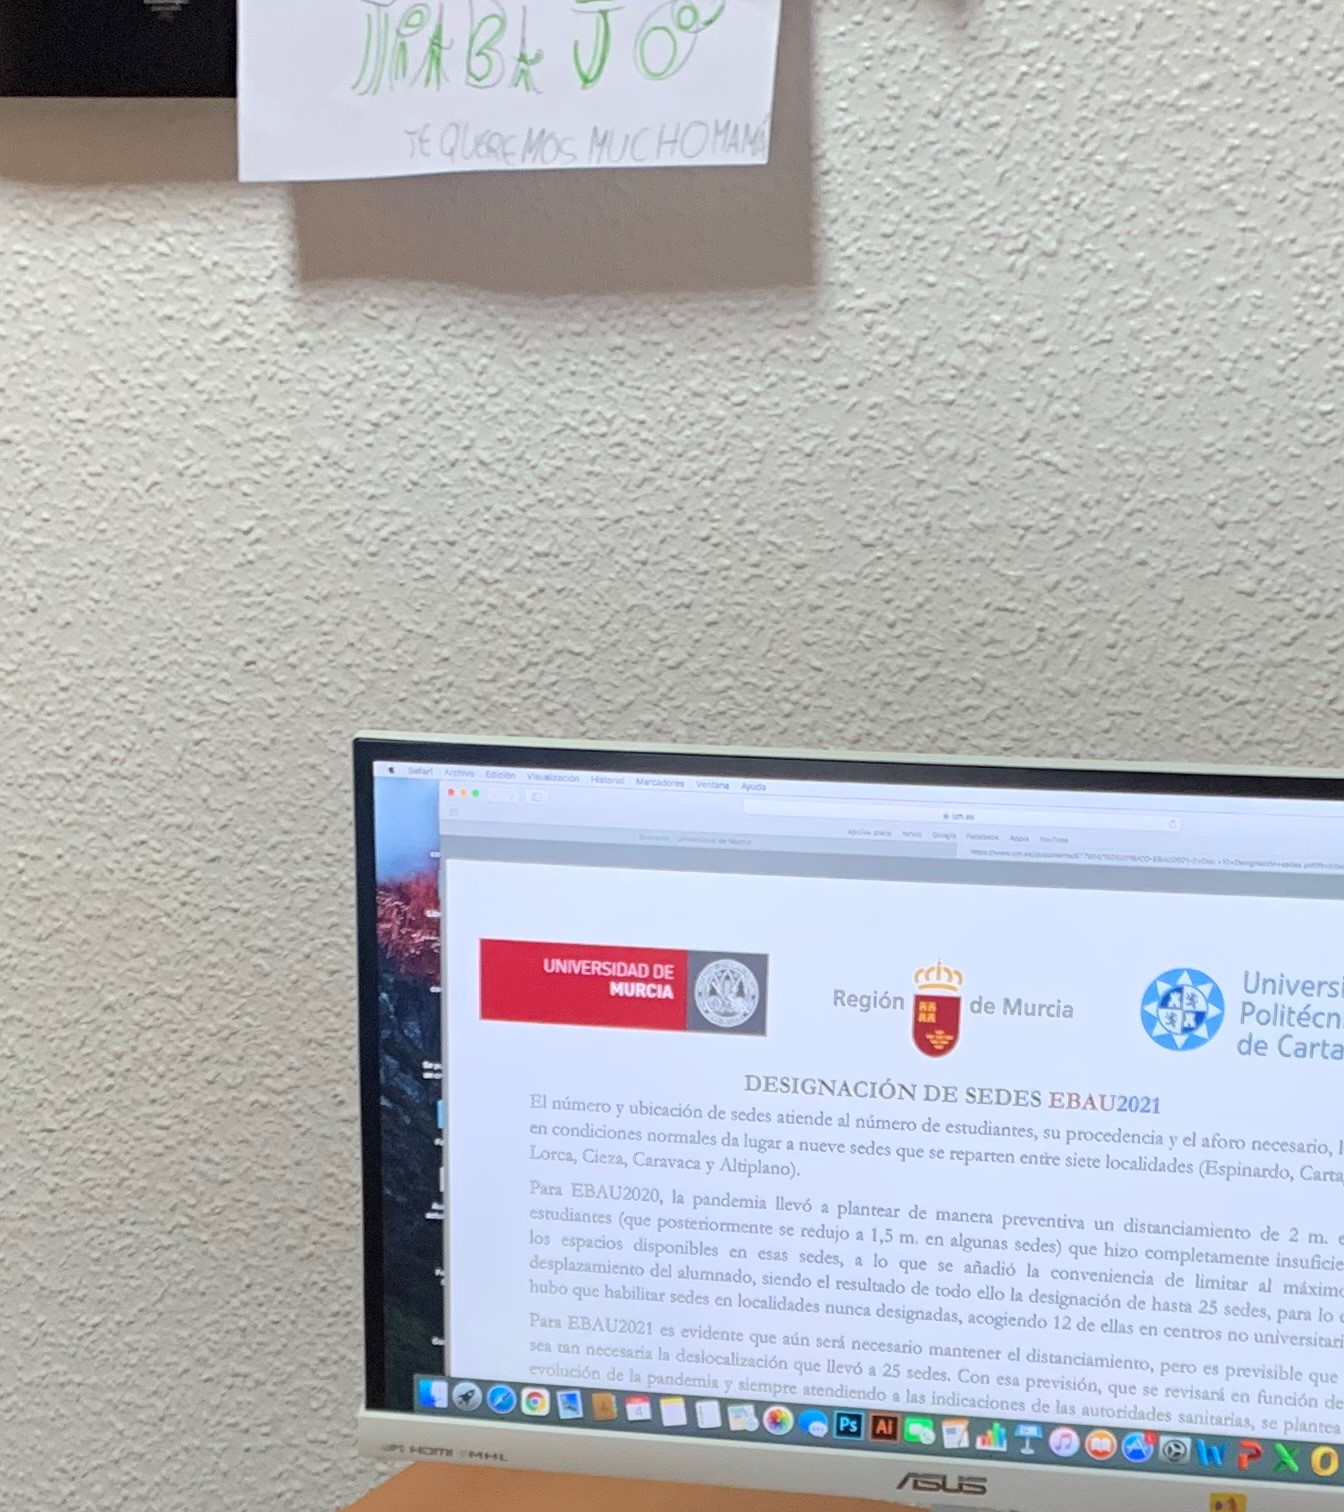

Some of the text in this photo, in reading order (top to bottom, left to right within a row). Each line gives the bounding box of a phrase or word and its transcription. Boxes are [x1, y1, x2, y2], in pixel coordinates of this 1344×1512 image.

[543, 957, 675, 981] UNIVERSIDAD DE
[609, 980, 675, 1000] MURCIA
[832, 987, 1075, 1020] Región de Murcia
[1236, 1031, 1269, 1057] de
[744, 1069, 1162, 1116] DESIGNACIÓN DE SEDES EBAU2021
[528, 1092, 548, 1109] El
[550, 1094, 612, 1114] número
[614, 1102, 625, 1119] y
[627, 1098, 703, 1119] ubicación
[705, 1103, 727, 1121] de
[729, 1105, 772, 1124] sedes
[775, 1107, 834, 1127] atiende
[836, 1110, 851, 1128] al
[854, 1112, 918, 1132] número
[920, 1115, 941, 1133] de
[943, 1118, 1039, 1142] estudiantes,
[1041, 1127, 1061, 1140] su
[1064, 1126, 1164, 1146] procedencia
[1167, 1134, 1179, 1151] y
[1181, 1130, 1197, 1148] el
[1199, 1131, 1246, 1151] aforo
[1249, 1137, 1334, 1158] necesario,
[528, 1122, 548, 1135] en
[550, 1121, 643, 1142] condiciones
[645, 1128, 718, 1146] normales
[719, 1130, 740, 1148] da
[742, 1131, 783, 1154] lugar
[784, 1138, 795, 1151] a
[797, 1139, 846, 1154] nueve
[848, 1138, 892, 1157] sedes
[894, 1145, 925, 1162] que
[927, 1147, 945, 1160] se
[948, 1148, 1016, 1166] reparten
[1018, 1150, 1061, 1167] entre
[1063, 1150, 1101, 1169] siete
[1103, 1151, 1194, 1175] localidades
[1197, 1158, 1295, 1184] (Espinardo,
[528, 1143, 801, 1181] Lorca, Cieza, Caravaca y Altiplano).
[528, 1178, 563, 1197] Para
[569, 1181, 664, 1206] EBAU2020,
[670, 1187, 685, 1205] la
[691, 1190, 768, 1211] pandemia
[774, 1194, 813, 1213] llevó
[819, 1202, 830, 1214] a
[835, 1198, 901, 1220] plantear
[906, 1202, 928, 1221] de
[934, 1208, 994, 1225] manera
[1000, 1212, 1085, 1231] preventiva
[1092, 1218, 1115, 1232] un
[1122, 1215, 1252, 1241] distanciamiento
[1258, 1223, 1281, 1242] de
[1287, 1225, 1300, 1243] 2
[1306, 1231, 1329, 1245] m.
[528, 1205, 613, 1225] estudiantes
[617, 1209, 651, 1231] (que
[655, 1214, 774, 1236] posteriormente
[777, 1224, 795, 1237] se
[799, 1222, 850, 1244] redujo
[854, 1229, 865, 1241] a
[870, 1225, 894, 1246] 1,5
[897, 1231, 919, 1246] m.
[924, 1233, 945, 1247] en
[948, 1231, 1009, 1253] algunas
[1013, 1235, 1063, 1258] sedes)
[1067, 1242, 1098, 1260] que
[1102, 1240, 1139, 1259] hizo
[1143, 1245, 1270, 1267] completamente
[838, 1415, 859, 1435] Ps
[875, 1417, 894, 1437] Ai
[896, 1471, 987, 1497] ASUS
